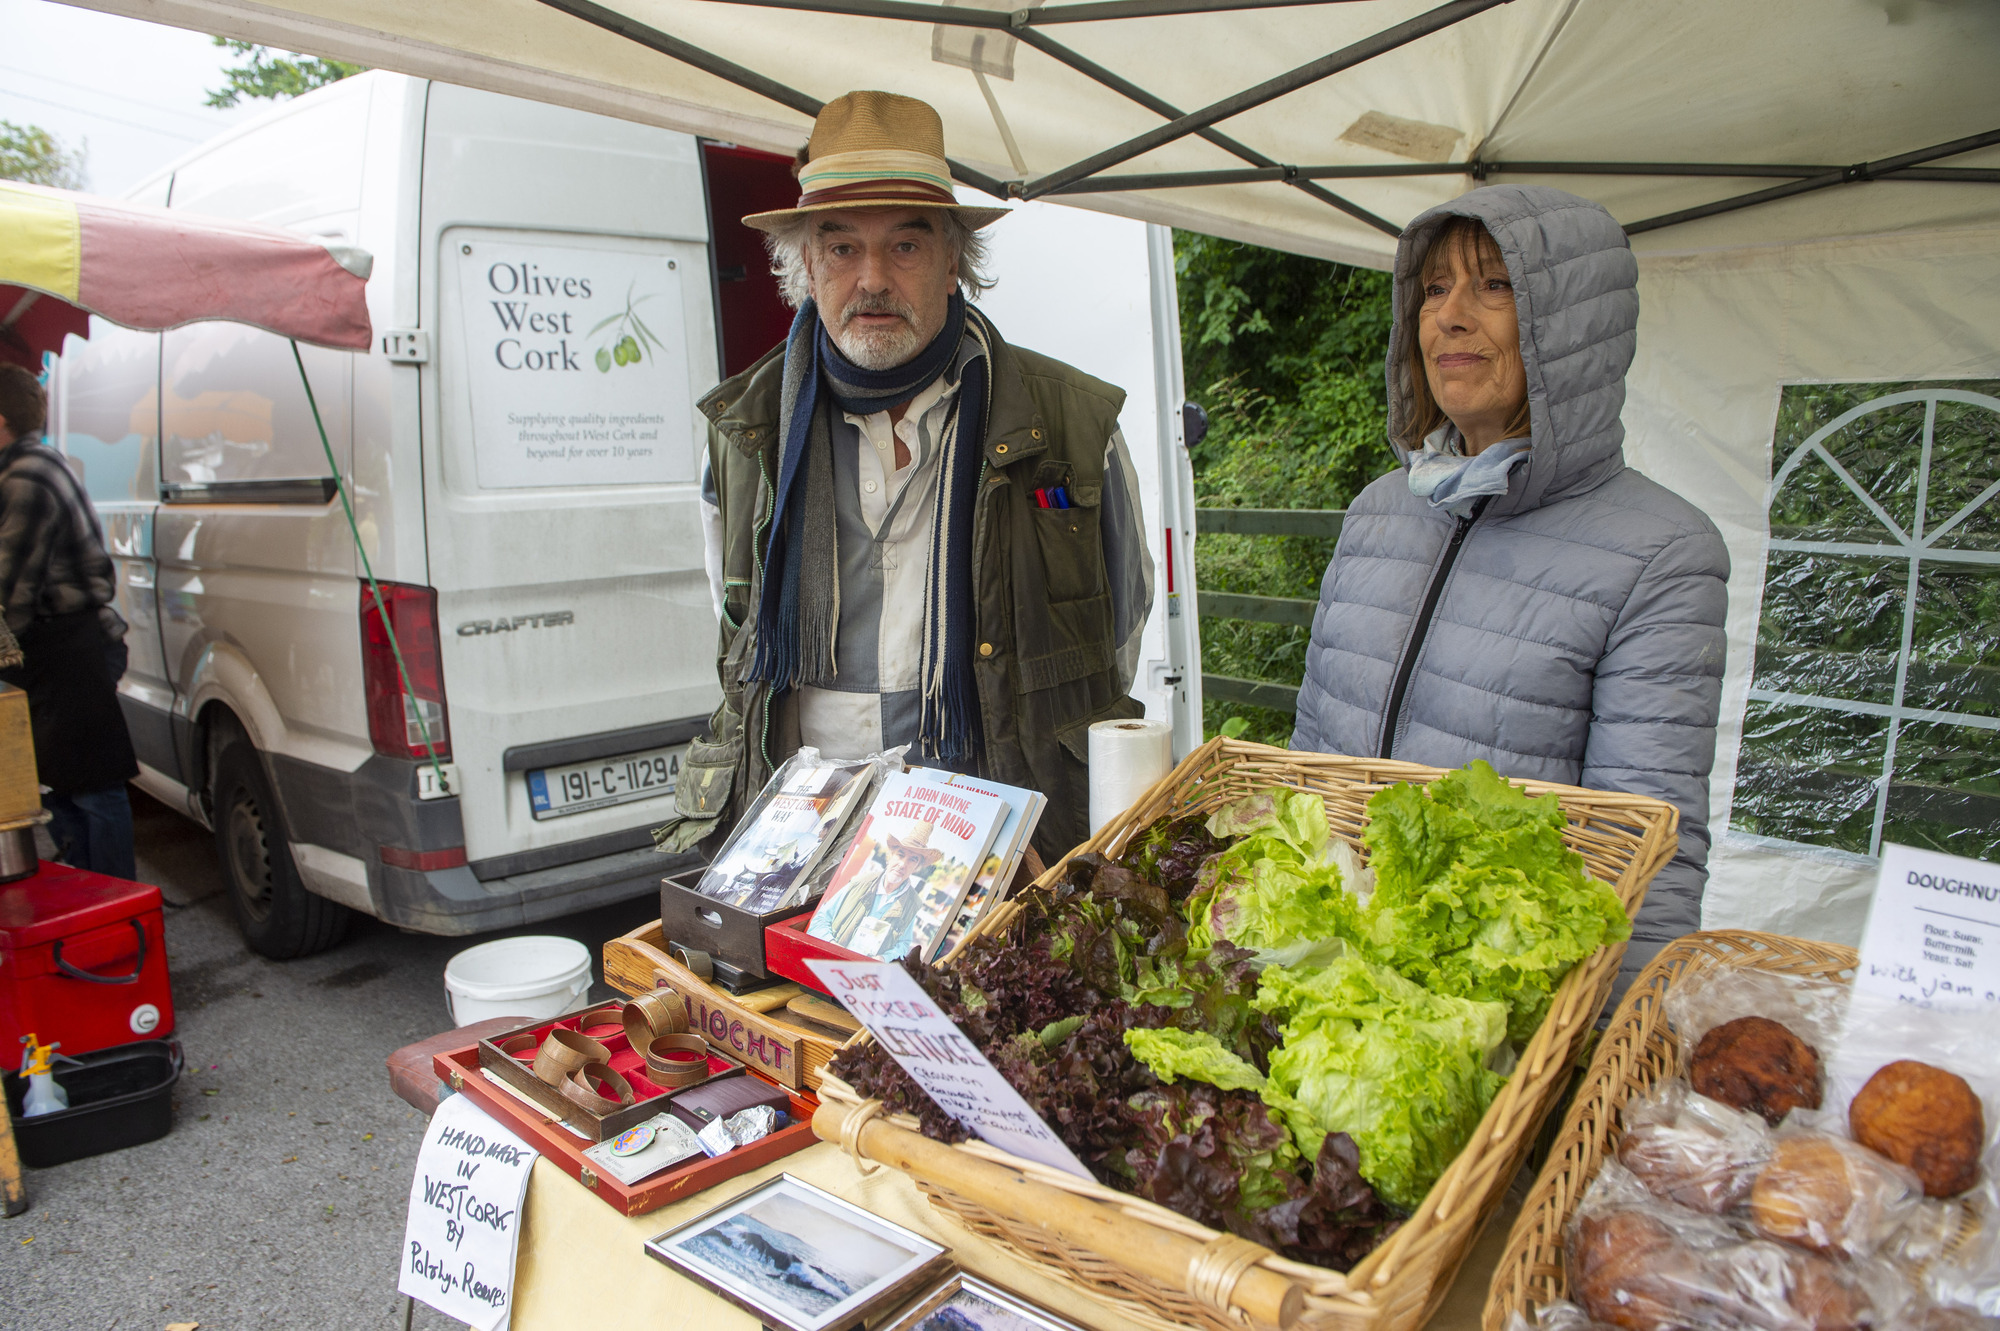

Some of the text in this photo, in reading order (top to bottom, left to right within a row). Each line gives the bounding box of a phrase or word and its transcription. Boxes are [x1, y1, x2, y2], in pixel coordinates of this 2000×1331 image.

[488, 262, 592, 299] Olives
[491, 301, 573, 334] West
[495, 338, 581, 371] Cork
[507, 412, 665, 427] Supplying quality ingredients
[518, 429, 658, 444] throughout West Cork and
[526, 446, 653, 461] beyond for over 10 years
[457, 610, 574, 636] CRAFTER
[562, 754, 680, 802] 191-C-11294
[793, 785, 812, 796] THE
[773, 798, 800, 809] WEST
[904, 786, 913, 798] A
[912, 788, 940, 803] JOHN
[938, 792, 972, 814] WAYNE
[771, 810, 793, 823] WAY
[884, 801, 977, 841] STATE OF MIND
[1871, 963, 2000, 1001] with jam o
[844, 994, 935, 1020] PICKED
[866, 1023, 986, 1067] LETTUCE
[960, 1077, 983, 1088] on
[437, 1126, 531, 1167] HANDMADE
[457, 1160, 480, 1180] IN
[424, 1175, 514, 1231] WEST CORK
[447, 1219, 464, 1251] BY
